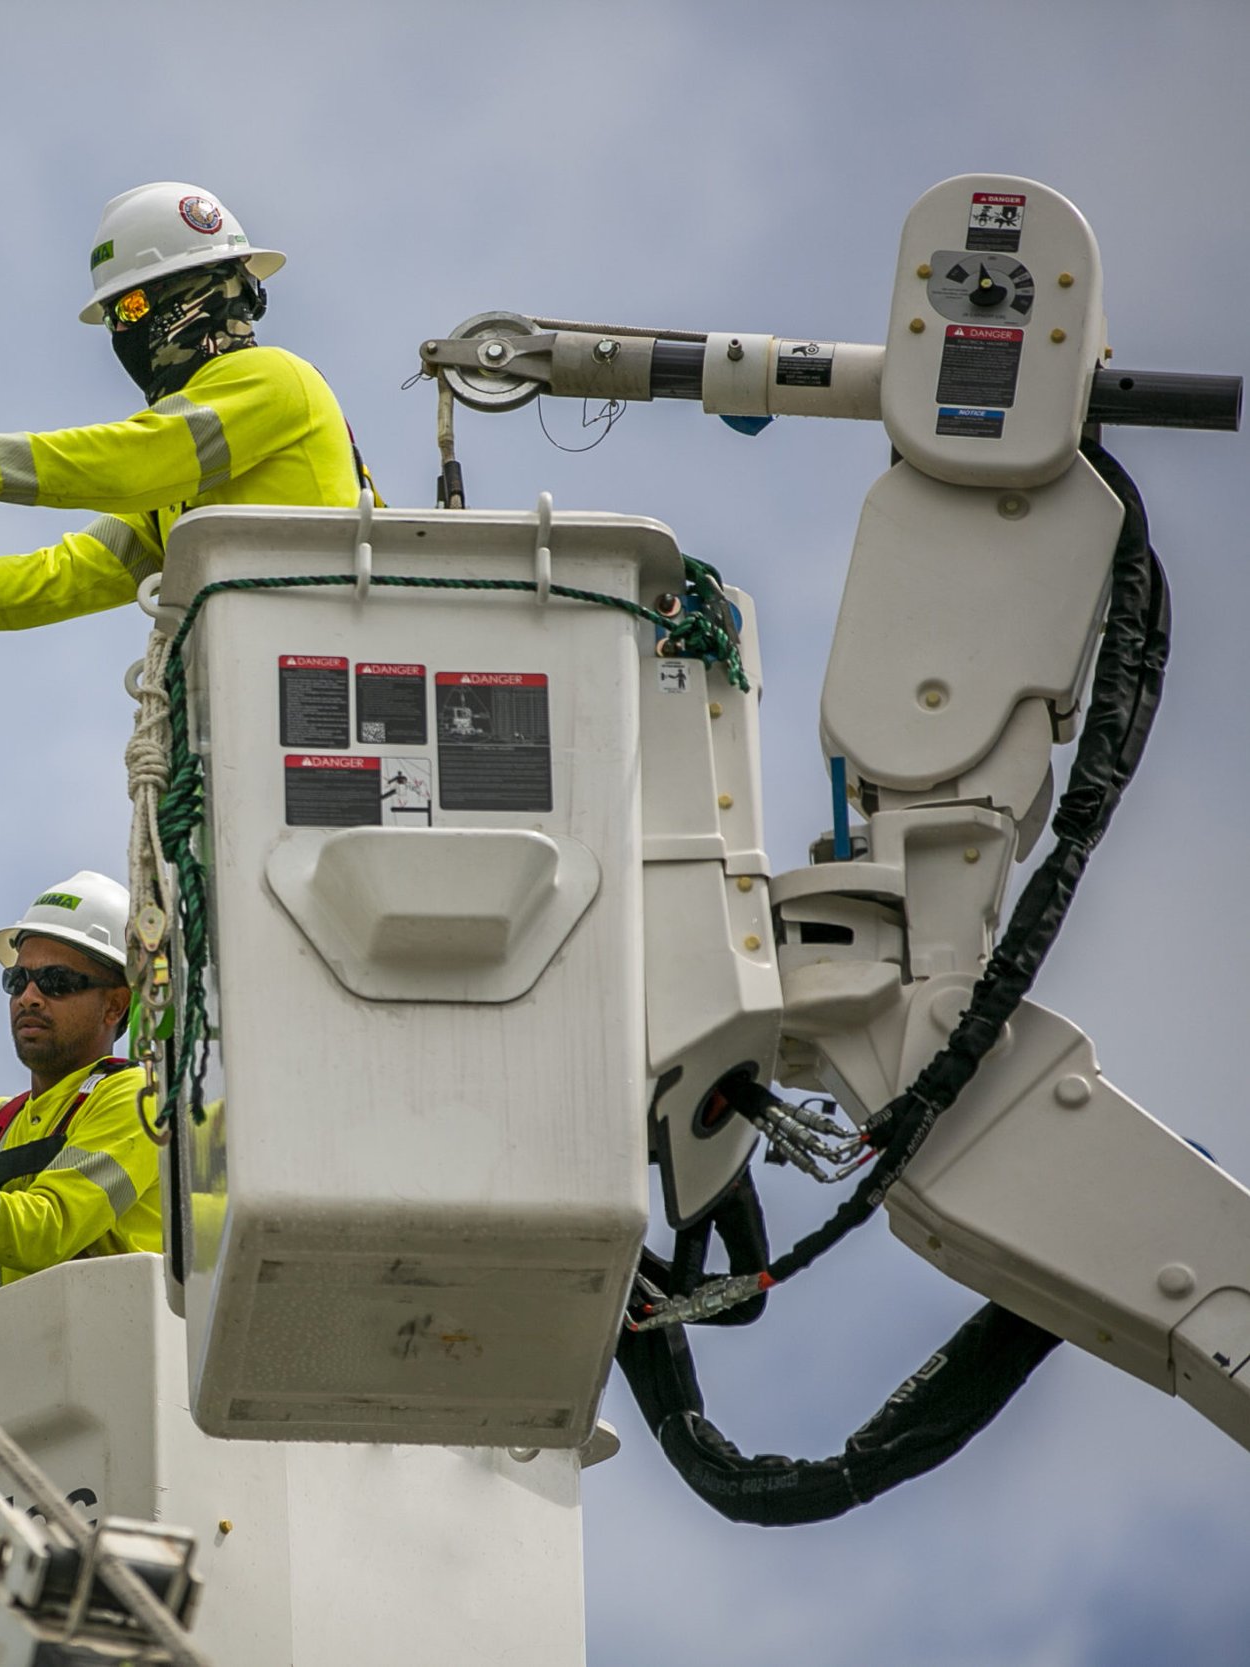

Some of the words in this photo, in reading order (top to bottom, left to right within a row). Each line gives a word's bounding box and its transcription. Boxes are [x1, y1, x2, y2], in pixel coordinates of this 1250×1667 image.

[970, 329, 1013, 339] DANGER
[958, 409, 987, 417] NOTICE
[297, 657, 341, 667] DANGER
[372, 665, 419, 675] DANGER
[471, 674, 523, 685] DANGER
[311, 757, 364, 768] DANGER
